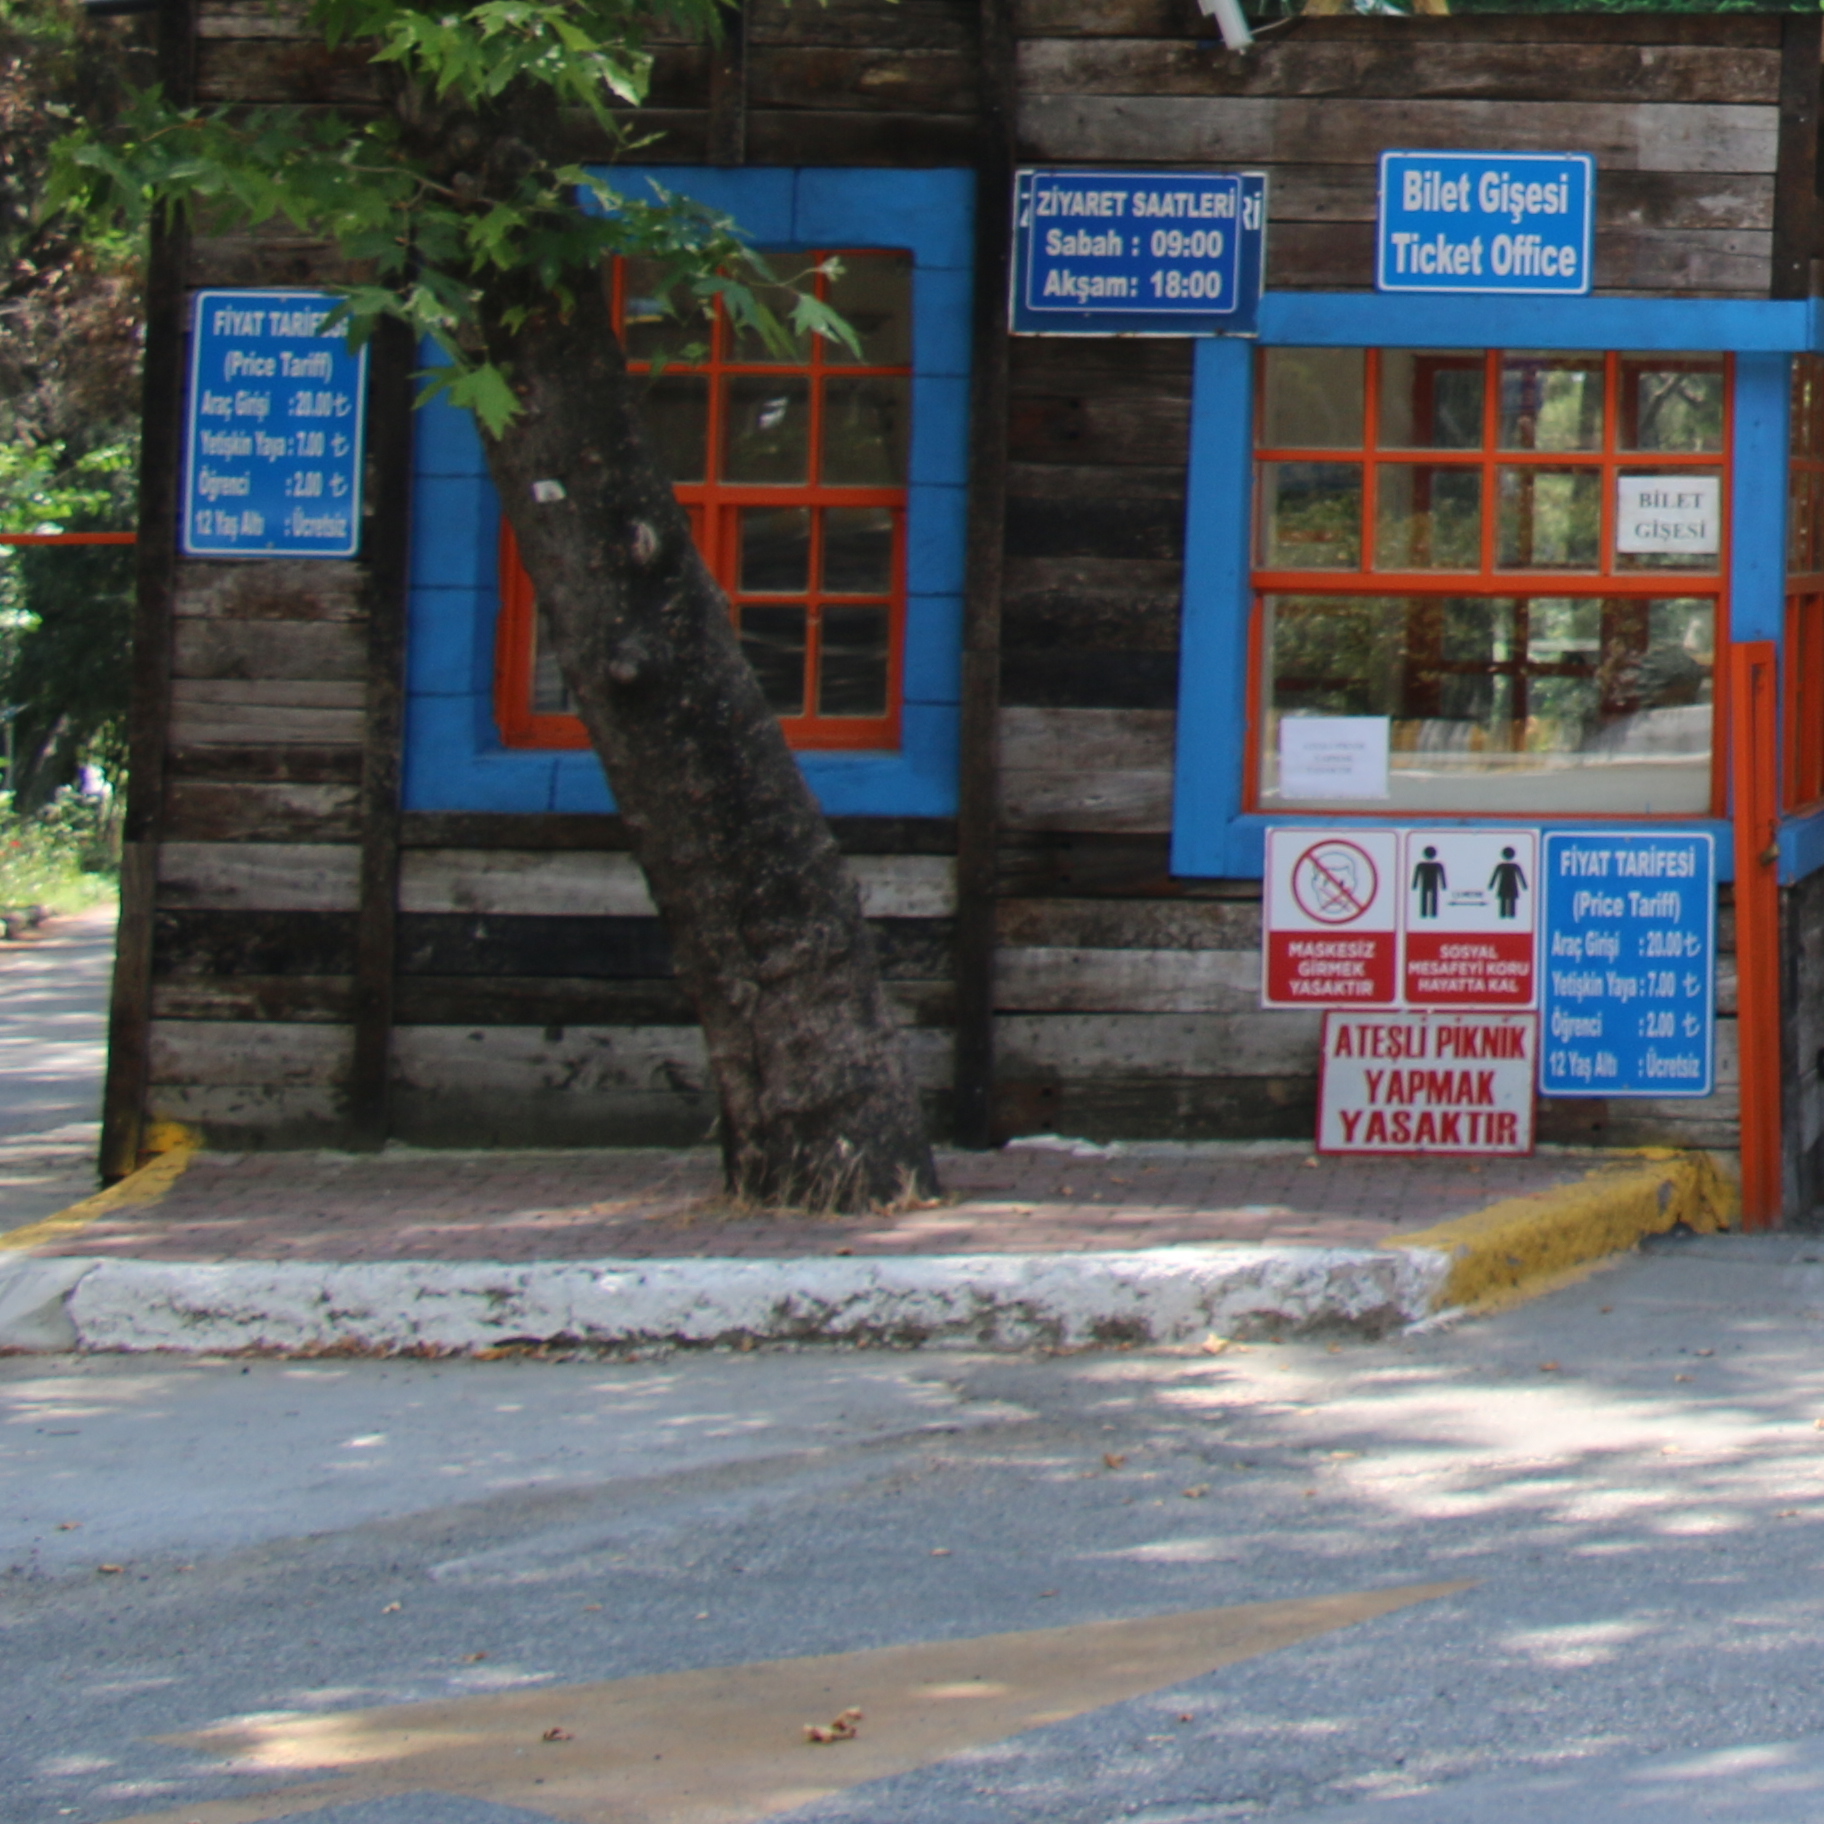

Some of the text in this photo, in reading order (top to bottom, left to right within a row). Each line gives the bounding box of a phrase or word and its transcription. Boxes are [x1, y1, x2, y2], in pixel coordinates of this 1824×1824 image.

[1036, 185, 1128, 217] ZİYARET
[1132, 187, 1235, 219] SAATLERİ
[1402, 170, 1569, 224] Bilet Gişesi
[1045, 228, 1123, 256] Sabah
[1150, 229, 1224, 259] 09:00
[1391, 232, 1577, 277] Ticket Office
[1150, 270, 1222, 299] 18:00
[212, 304, 265, 336] FİYAT
[224, 350, 334, 384] (Price Tariff)
[201, 390, 233, 422] Araç
[234, 390, 271, 423] Girişi
[200, 430, 253, 461] Yetişkin
[255, 430, 286, 462] Yaya
[198, 464, 249, 502] Öğrenci
[1639, 490, 1704, 509] BİLET
[195, 510, 212, 535] 12
[214, 511, 238, 541] Yaş
[1635, 520, 1705, 542] GİŞESİ
[1560, 845, 1696, 878] FİYAT TARİFESİ
[1573, 890, 1682, 924] (Price Tariff)
[1288, 940, 1377, 959] MASKESİZ
[1440, 943, 1498, 960] SOSYAL
[1551, 932, 1583, 964] Araç
[1584, 931, 1621, 964] Girişi
[1298, 959, 1365, 977] GİRMEK
[1408, 960, 1531, 977] MESAFEYİ KORU
[1290, 980, 1374, 997] YASAKTIR
[1418, 978, 1519, 994] HAYATTA KAL
[1552, 971, 1604, 1003] Yetişkin
[1605, 972, 1637, 1004] Yaya
[1551, 1006, 1603, 1044] Öğrenci
[1549, 1051, 1566, 1077] 12
[1567, 1051, 1592, 1084] Yaş
[1594, 1052, 1618, 1078] Altı
[1365, 1069, 1494, 1106] YAPMAK
[1340, 1110, 1518, 1144] YASAKTIR
